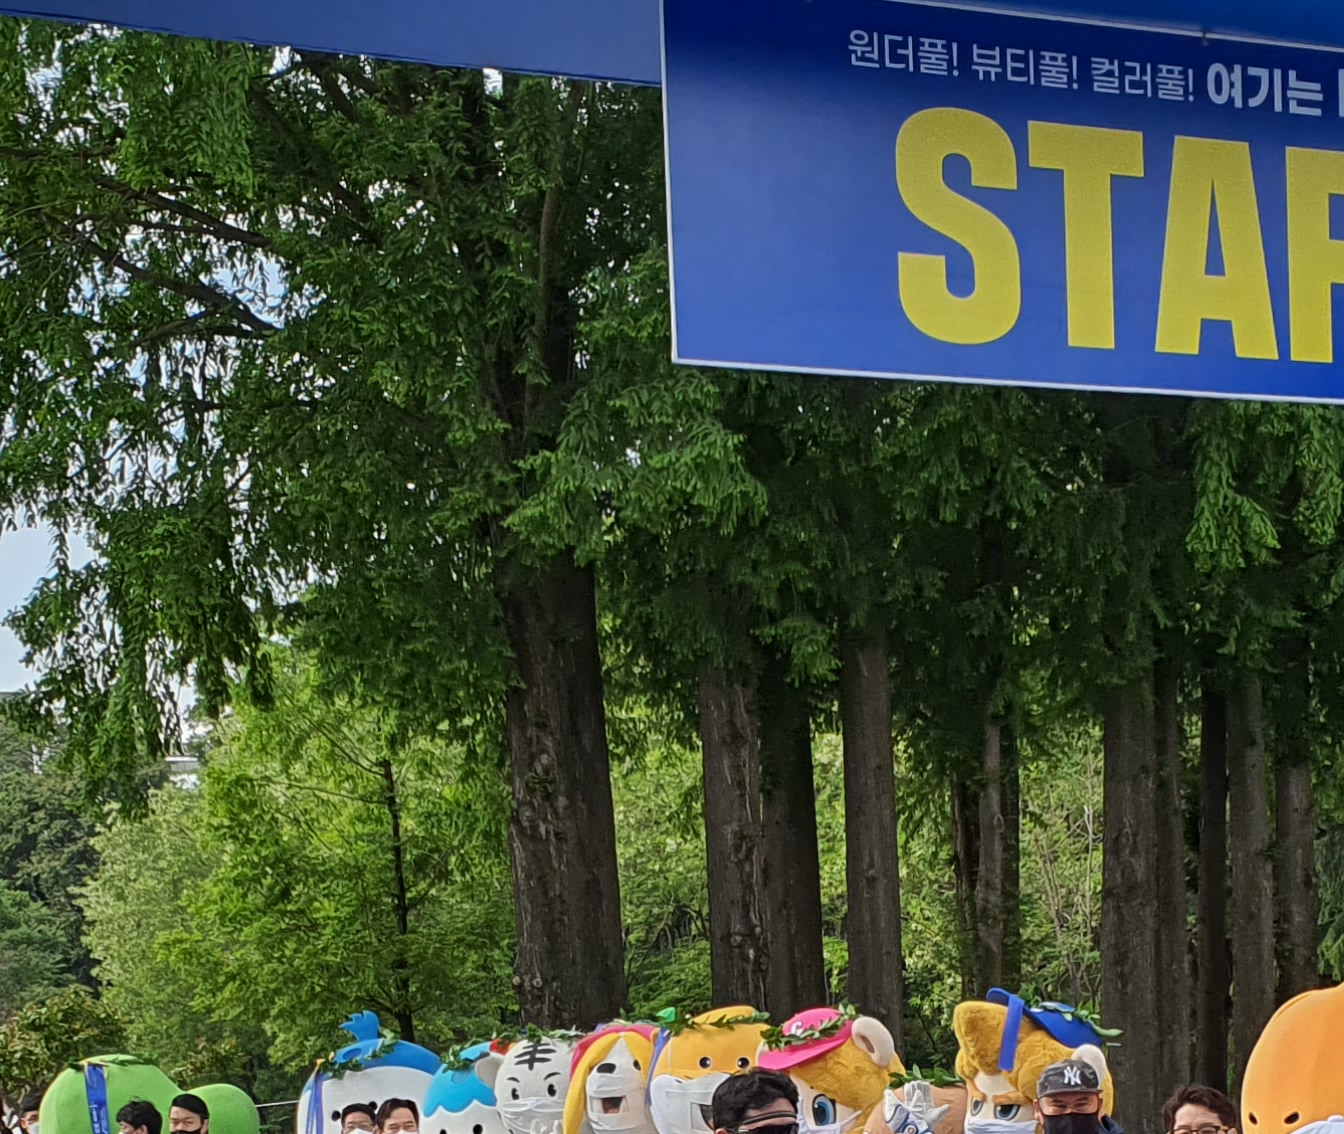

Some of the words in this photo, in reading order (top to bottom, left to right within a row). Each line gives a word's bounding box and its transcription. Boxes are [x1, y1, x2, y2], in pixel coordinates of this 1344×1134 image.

[847, 29, 961, 78] 원더풀!
[970, 44, 1080, 92] 뷰티풀!
[1090, 56, 1195, 103] 컬러풀!
[1205, 61, 1324, 118] 여기는
